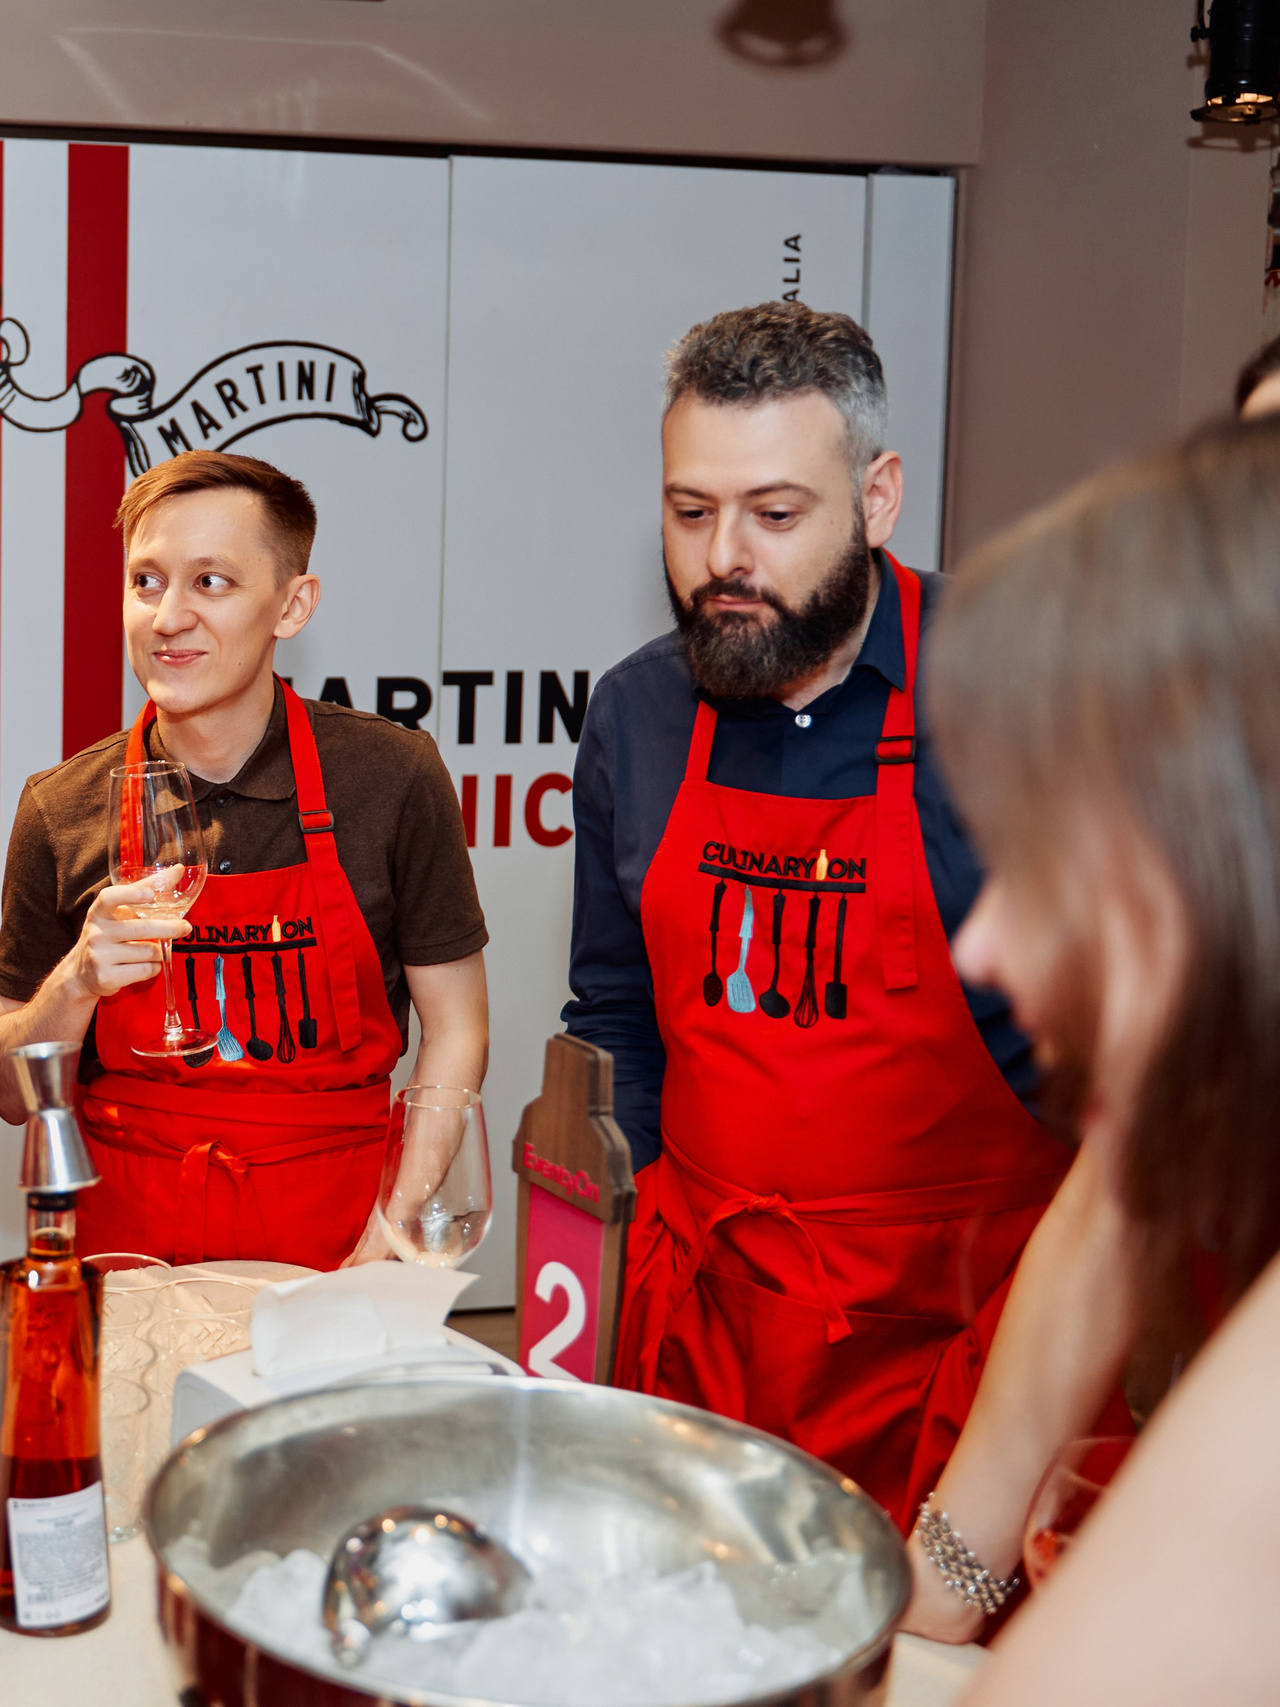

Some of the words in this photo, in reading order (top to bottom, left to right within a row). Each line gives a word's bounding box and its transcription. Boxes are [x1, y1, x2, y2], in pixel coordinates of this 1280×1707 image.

[782, 234, 801, 301] ALIA
[157, 361, 335, 456] MARTINI
[528, 1261, 587, 1384] 2
